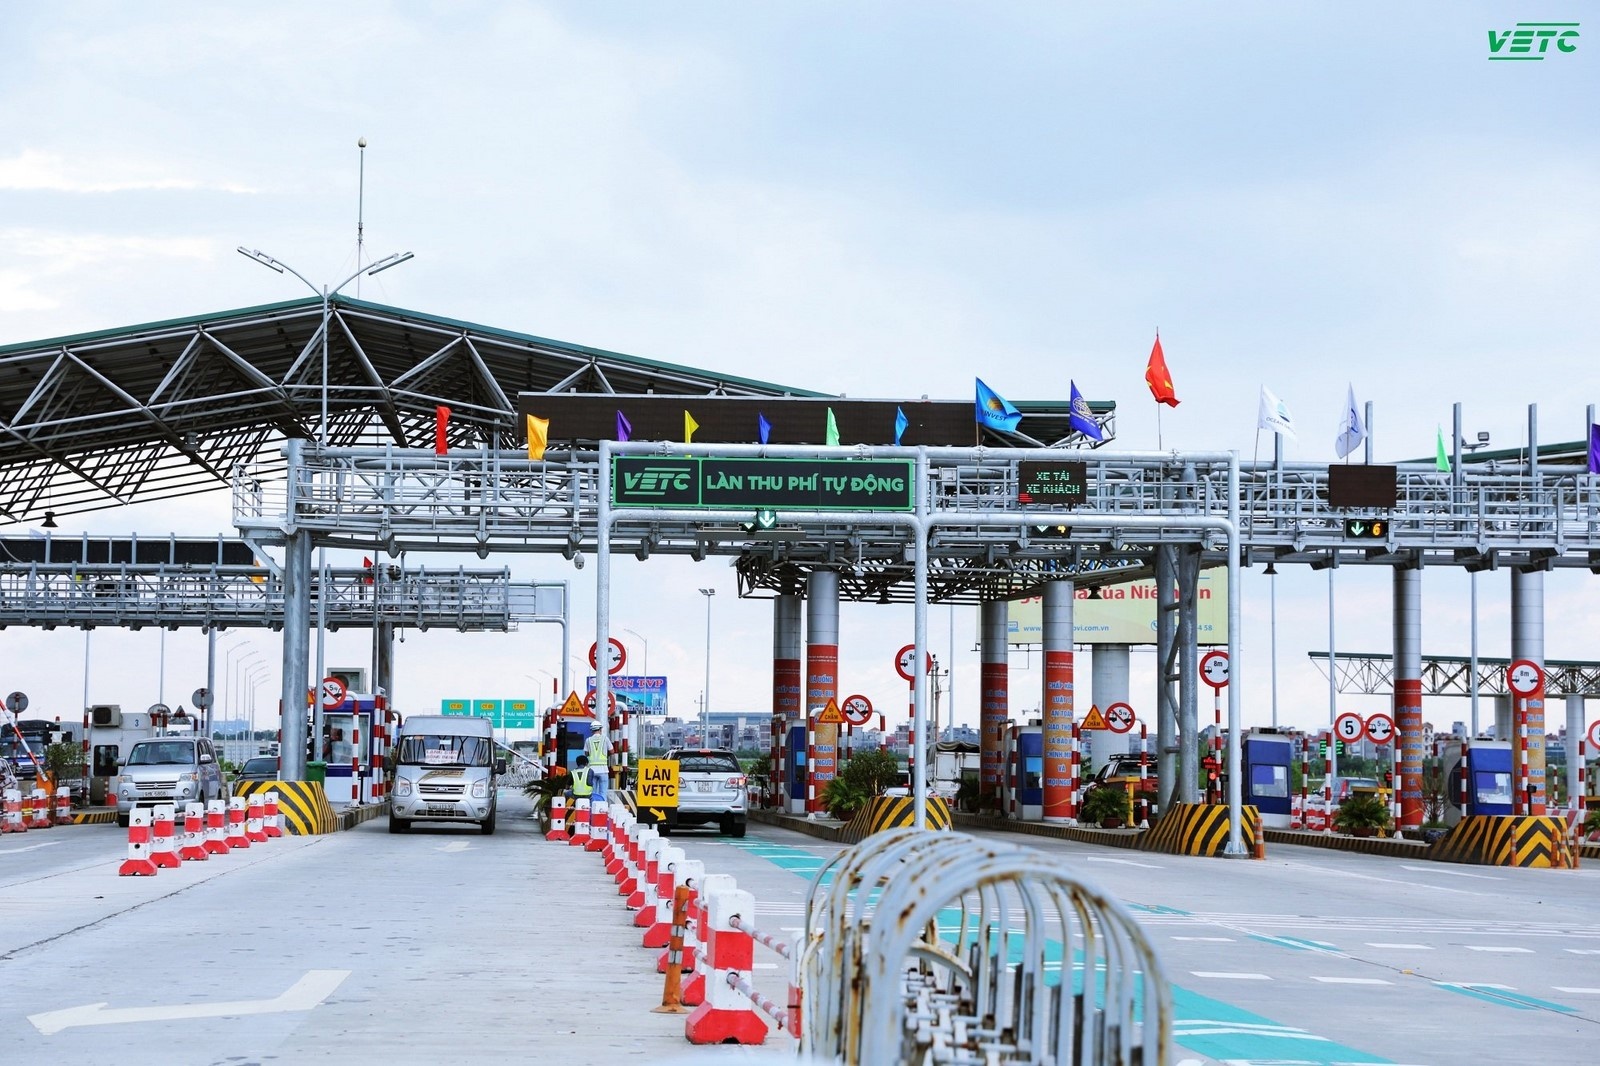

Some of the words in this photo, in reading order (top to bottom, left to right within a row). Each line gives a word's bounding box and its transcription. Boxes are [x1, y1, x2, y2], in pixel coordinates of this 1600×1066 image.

[623, 471, 691, 491] VETC
[1036, 471, 1051, 481] XE
[706, 471, 743, 490] LÀN
[747, 475, 783, 491] THU
[788, 472, 819, 491] PHÍ
[822, 475, 848, 496] TỰ
[850, 473, 904, 496] ĐỘNG
[1026, 483, 1041, 494] XE
[1042, 482, 1081, 494] KHÁCH
[1372, 523, 1382, 537] 6
[637, 679, 663, 688] TVP
[134, 719, 140, 727] 3
[1345, 720, 1354, 735] 5
[645, 765, 671, 781] LÀN
[642, 784, 675, 797] VETC
